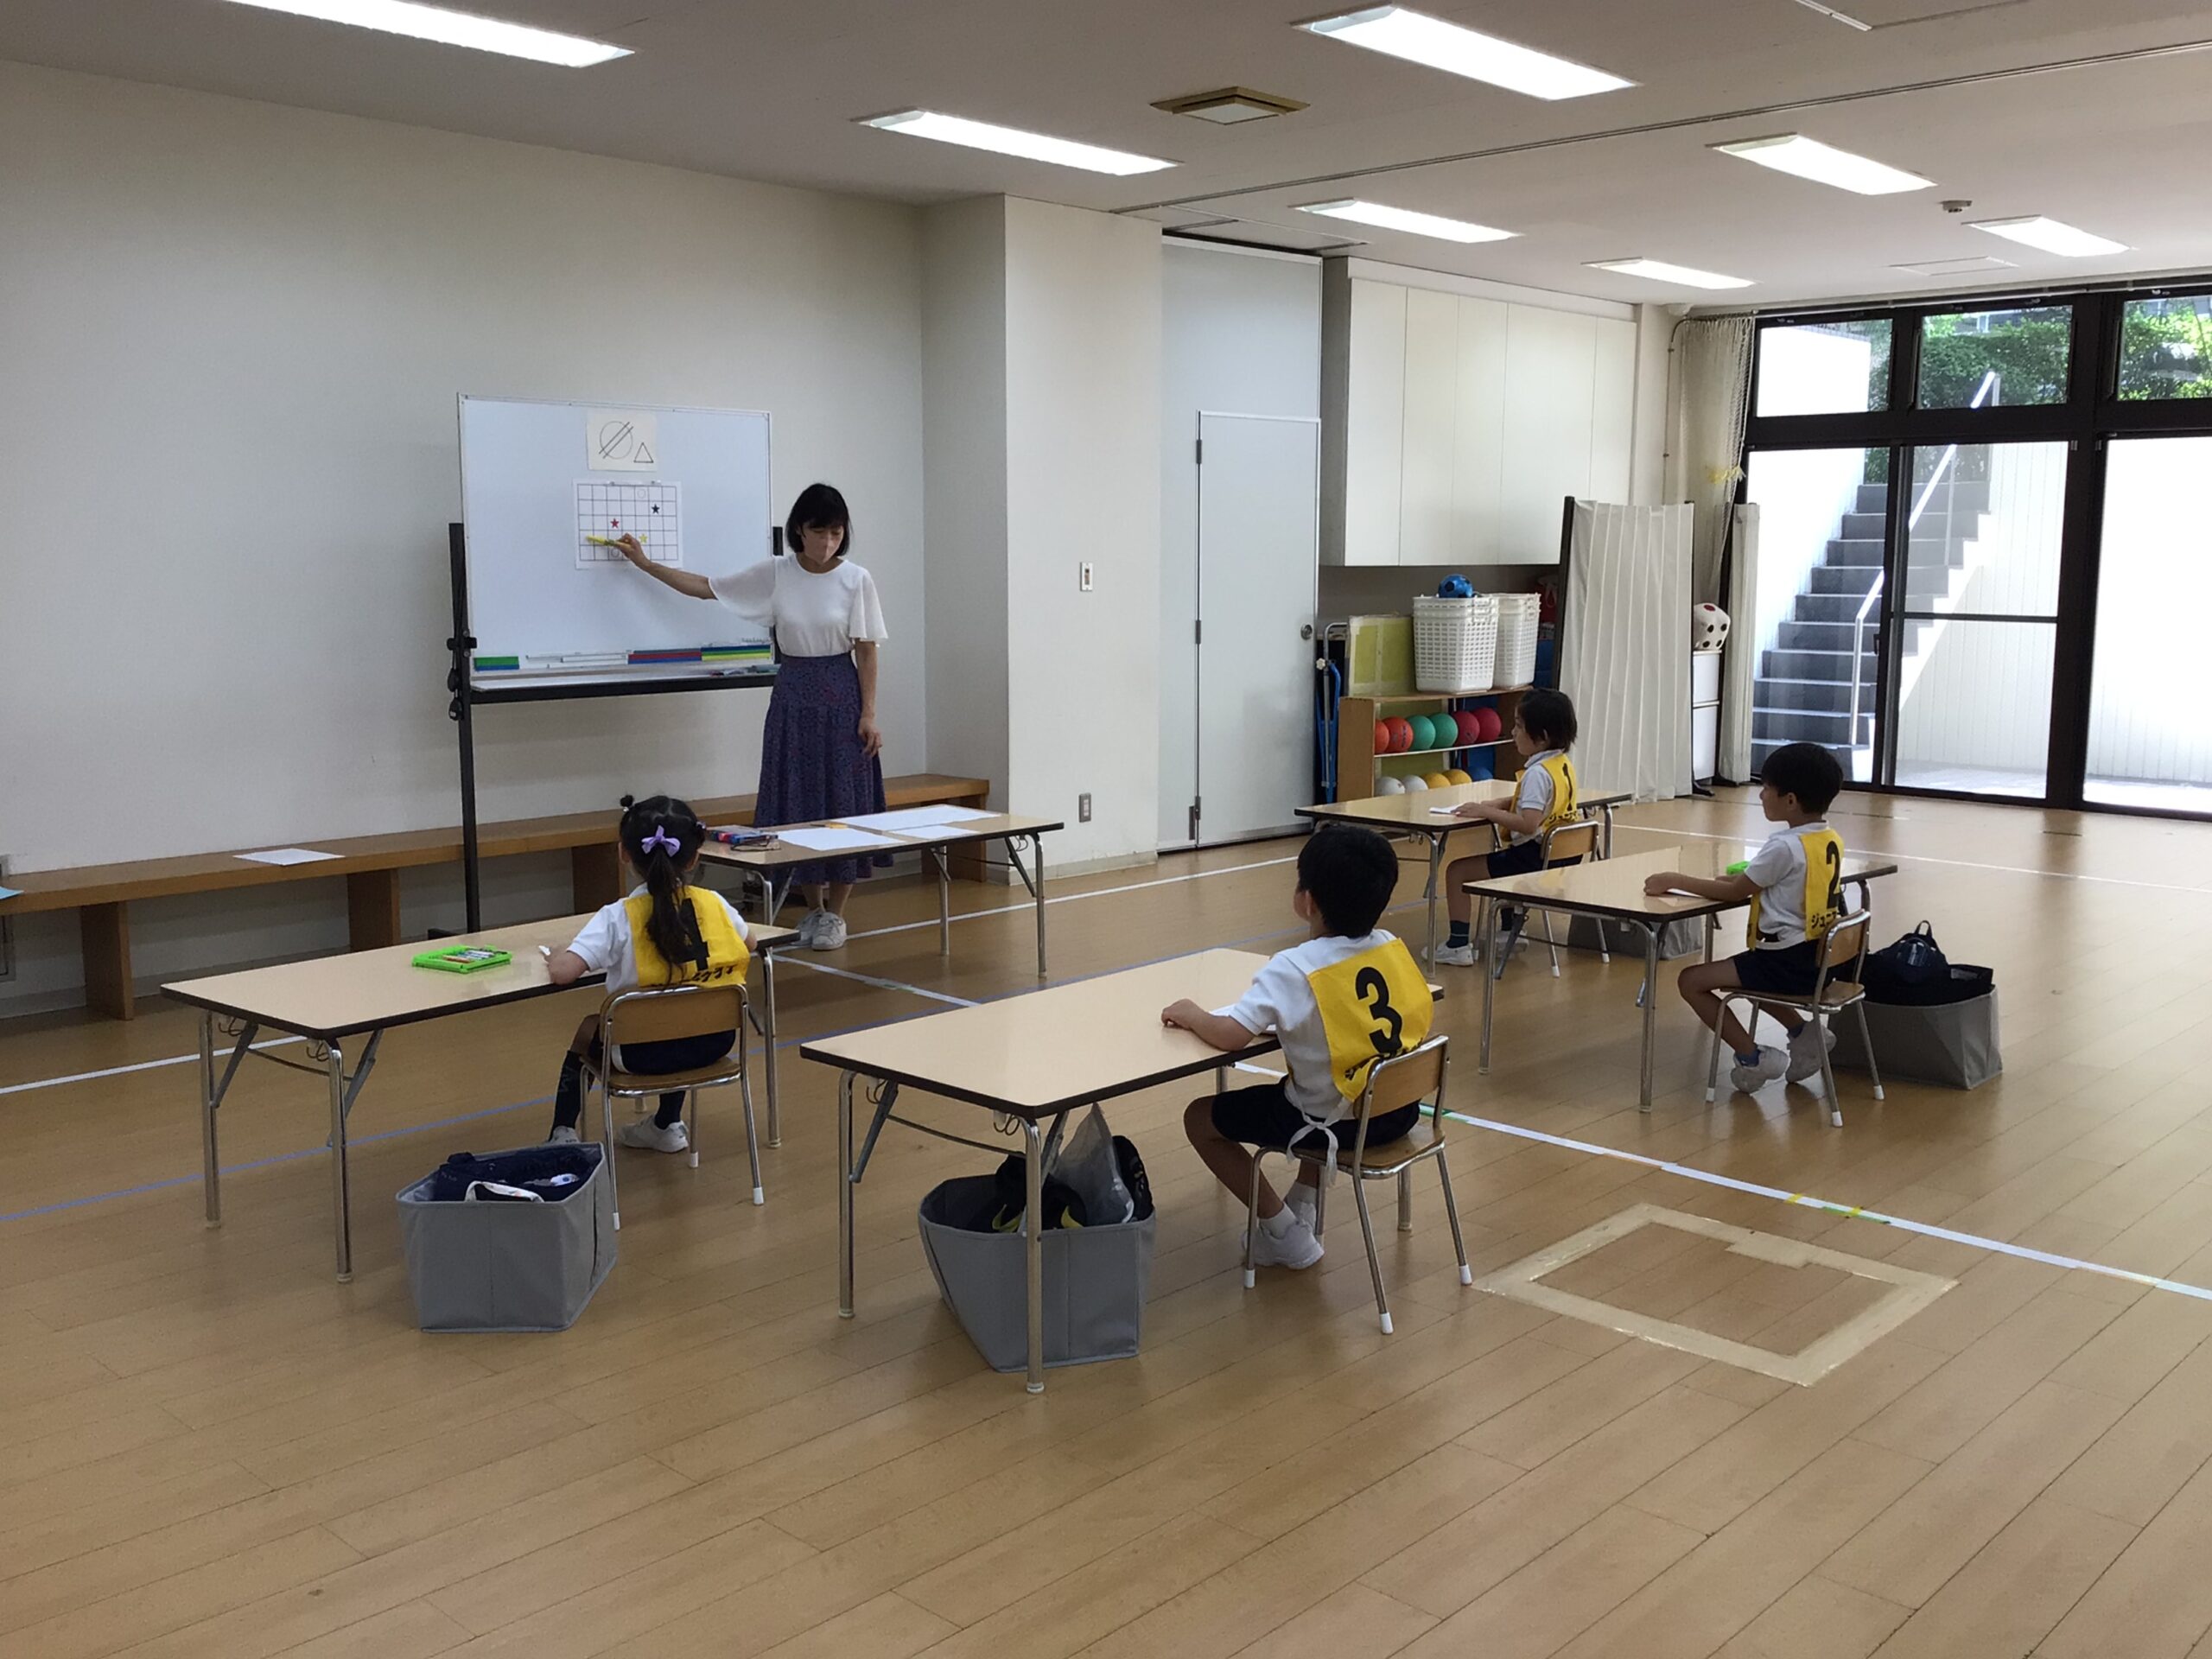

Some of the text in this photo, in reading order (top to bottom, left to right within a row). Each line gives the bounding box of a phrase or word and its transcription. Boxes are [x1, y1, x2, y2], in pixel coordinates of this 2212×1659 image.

[1562, 763, 1573, 811] 1
[1826, 840, 1840, 909] 2
[1355, 966, 1402, 1056] 3
